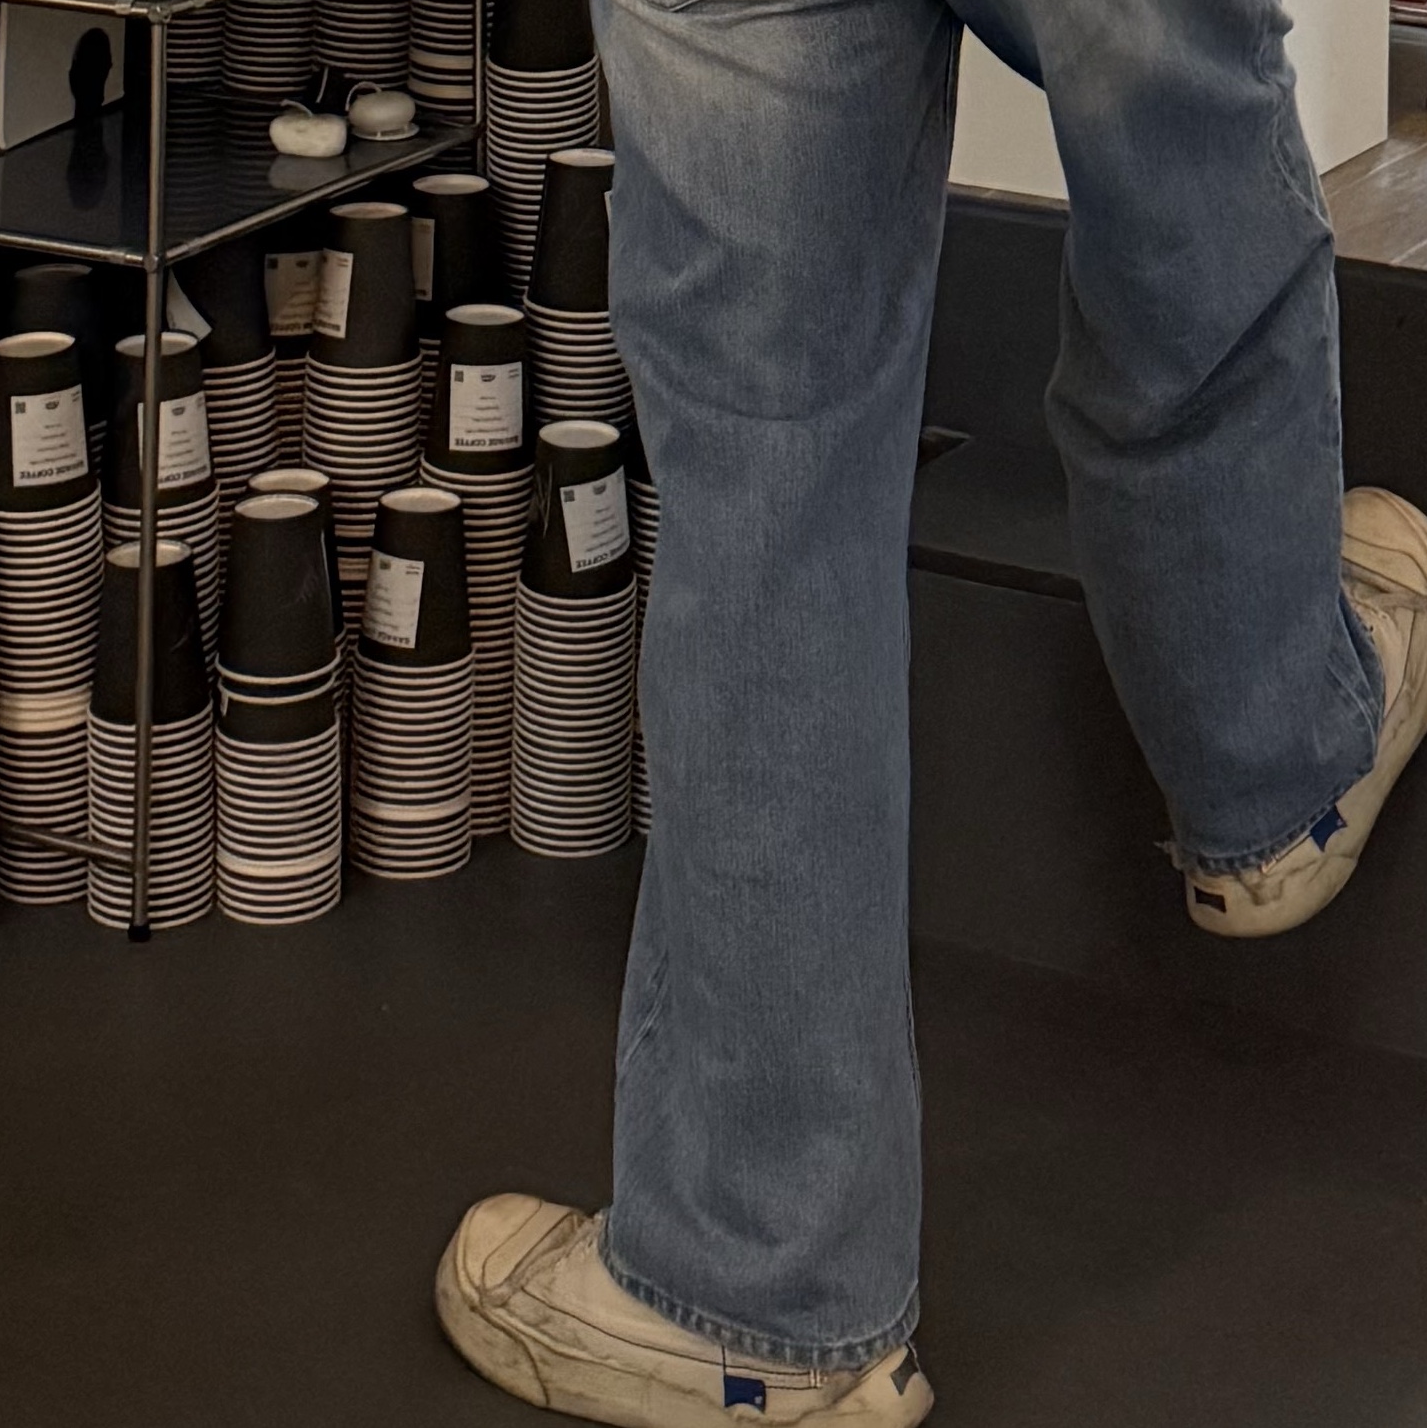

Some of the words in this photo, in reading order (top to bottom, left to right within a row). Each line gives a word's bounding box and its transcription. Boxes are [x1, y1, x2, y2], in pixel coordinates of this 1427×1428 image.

[454, 437, 487, 447] COFFEE
[19, 467, 54, 480] COFFEE
[575, 553, 609, 569] COFFEE
